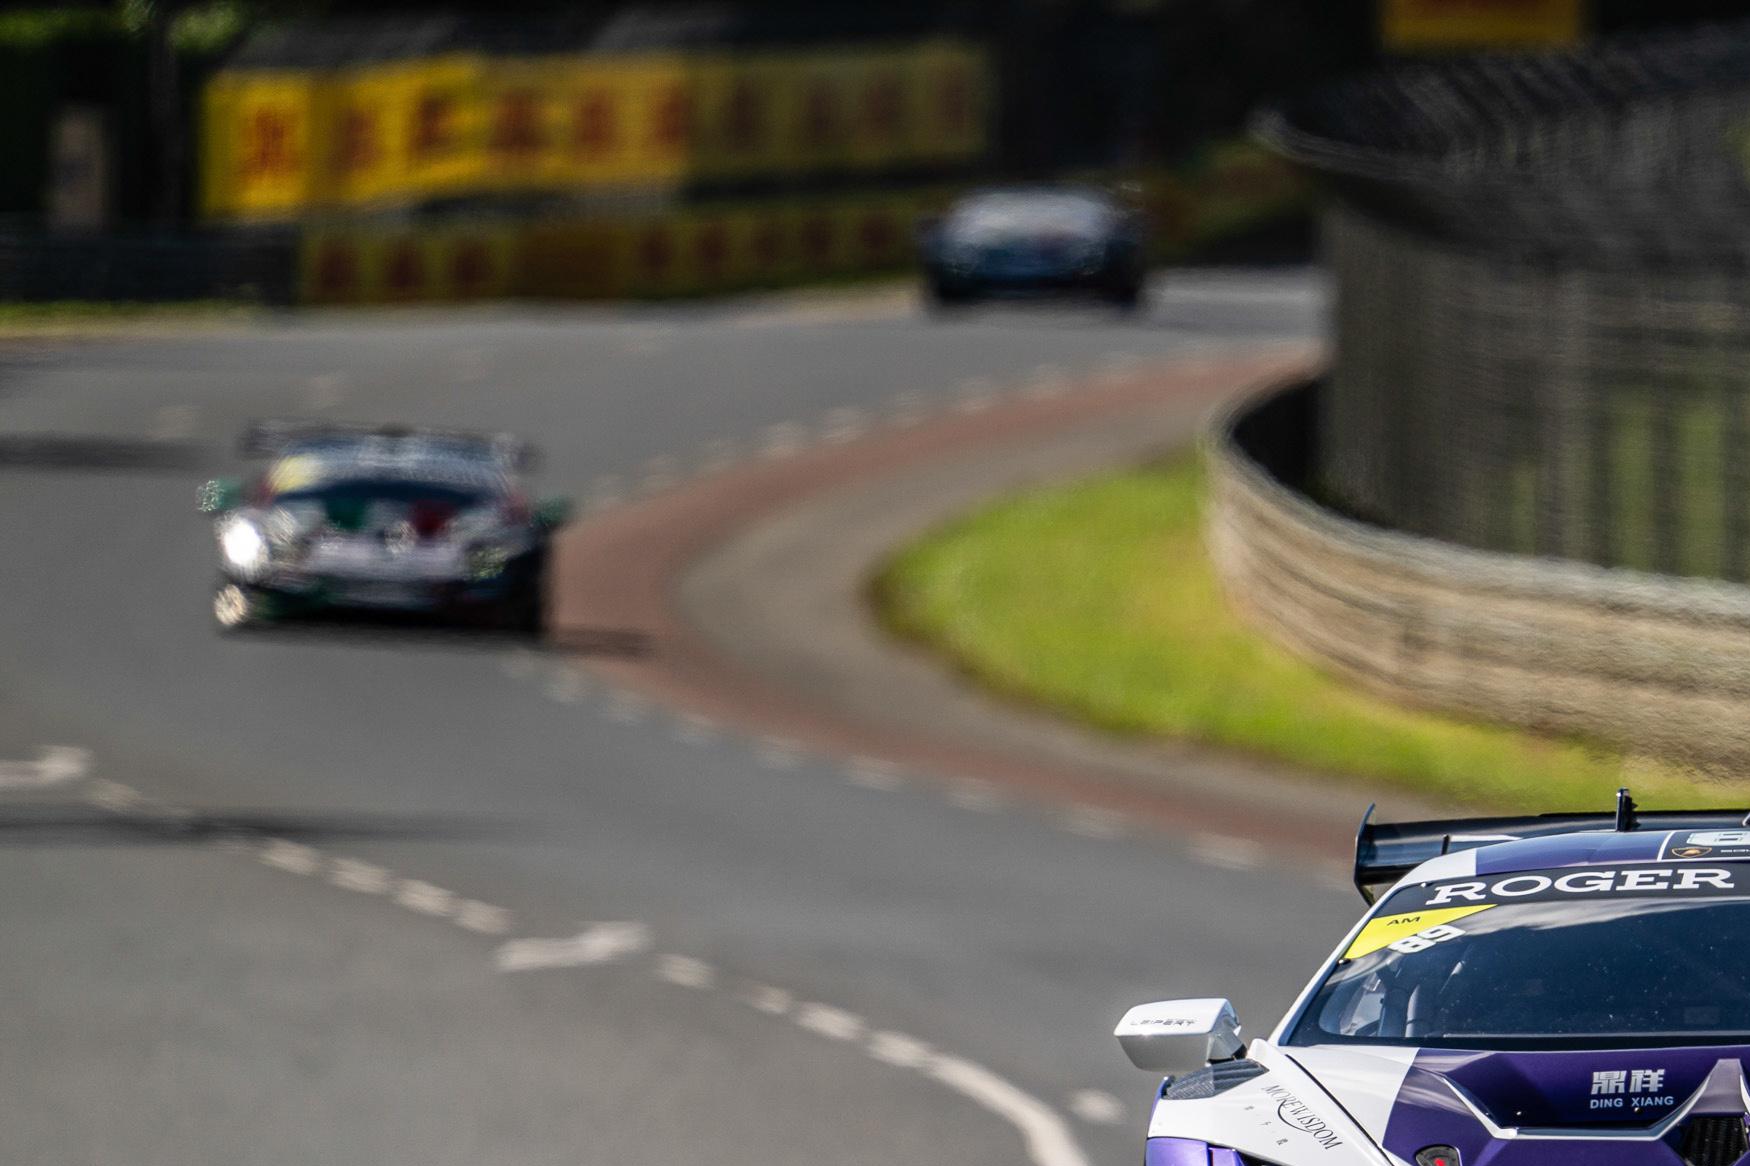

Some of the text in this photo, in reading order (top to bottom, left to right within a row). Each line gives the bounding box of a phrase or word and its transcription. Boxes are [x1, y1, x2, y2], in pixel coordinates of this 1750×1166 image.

[1425, 868, 1735, 905] ROGER
[1386, 916, 1420, 927] AM
[1388, 924, 1467, 954] 89
[1590, 1068, 1666, 1095] 鼎祥
[1589, 1095, 1675, 1109] DING XIANG
